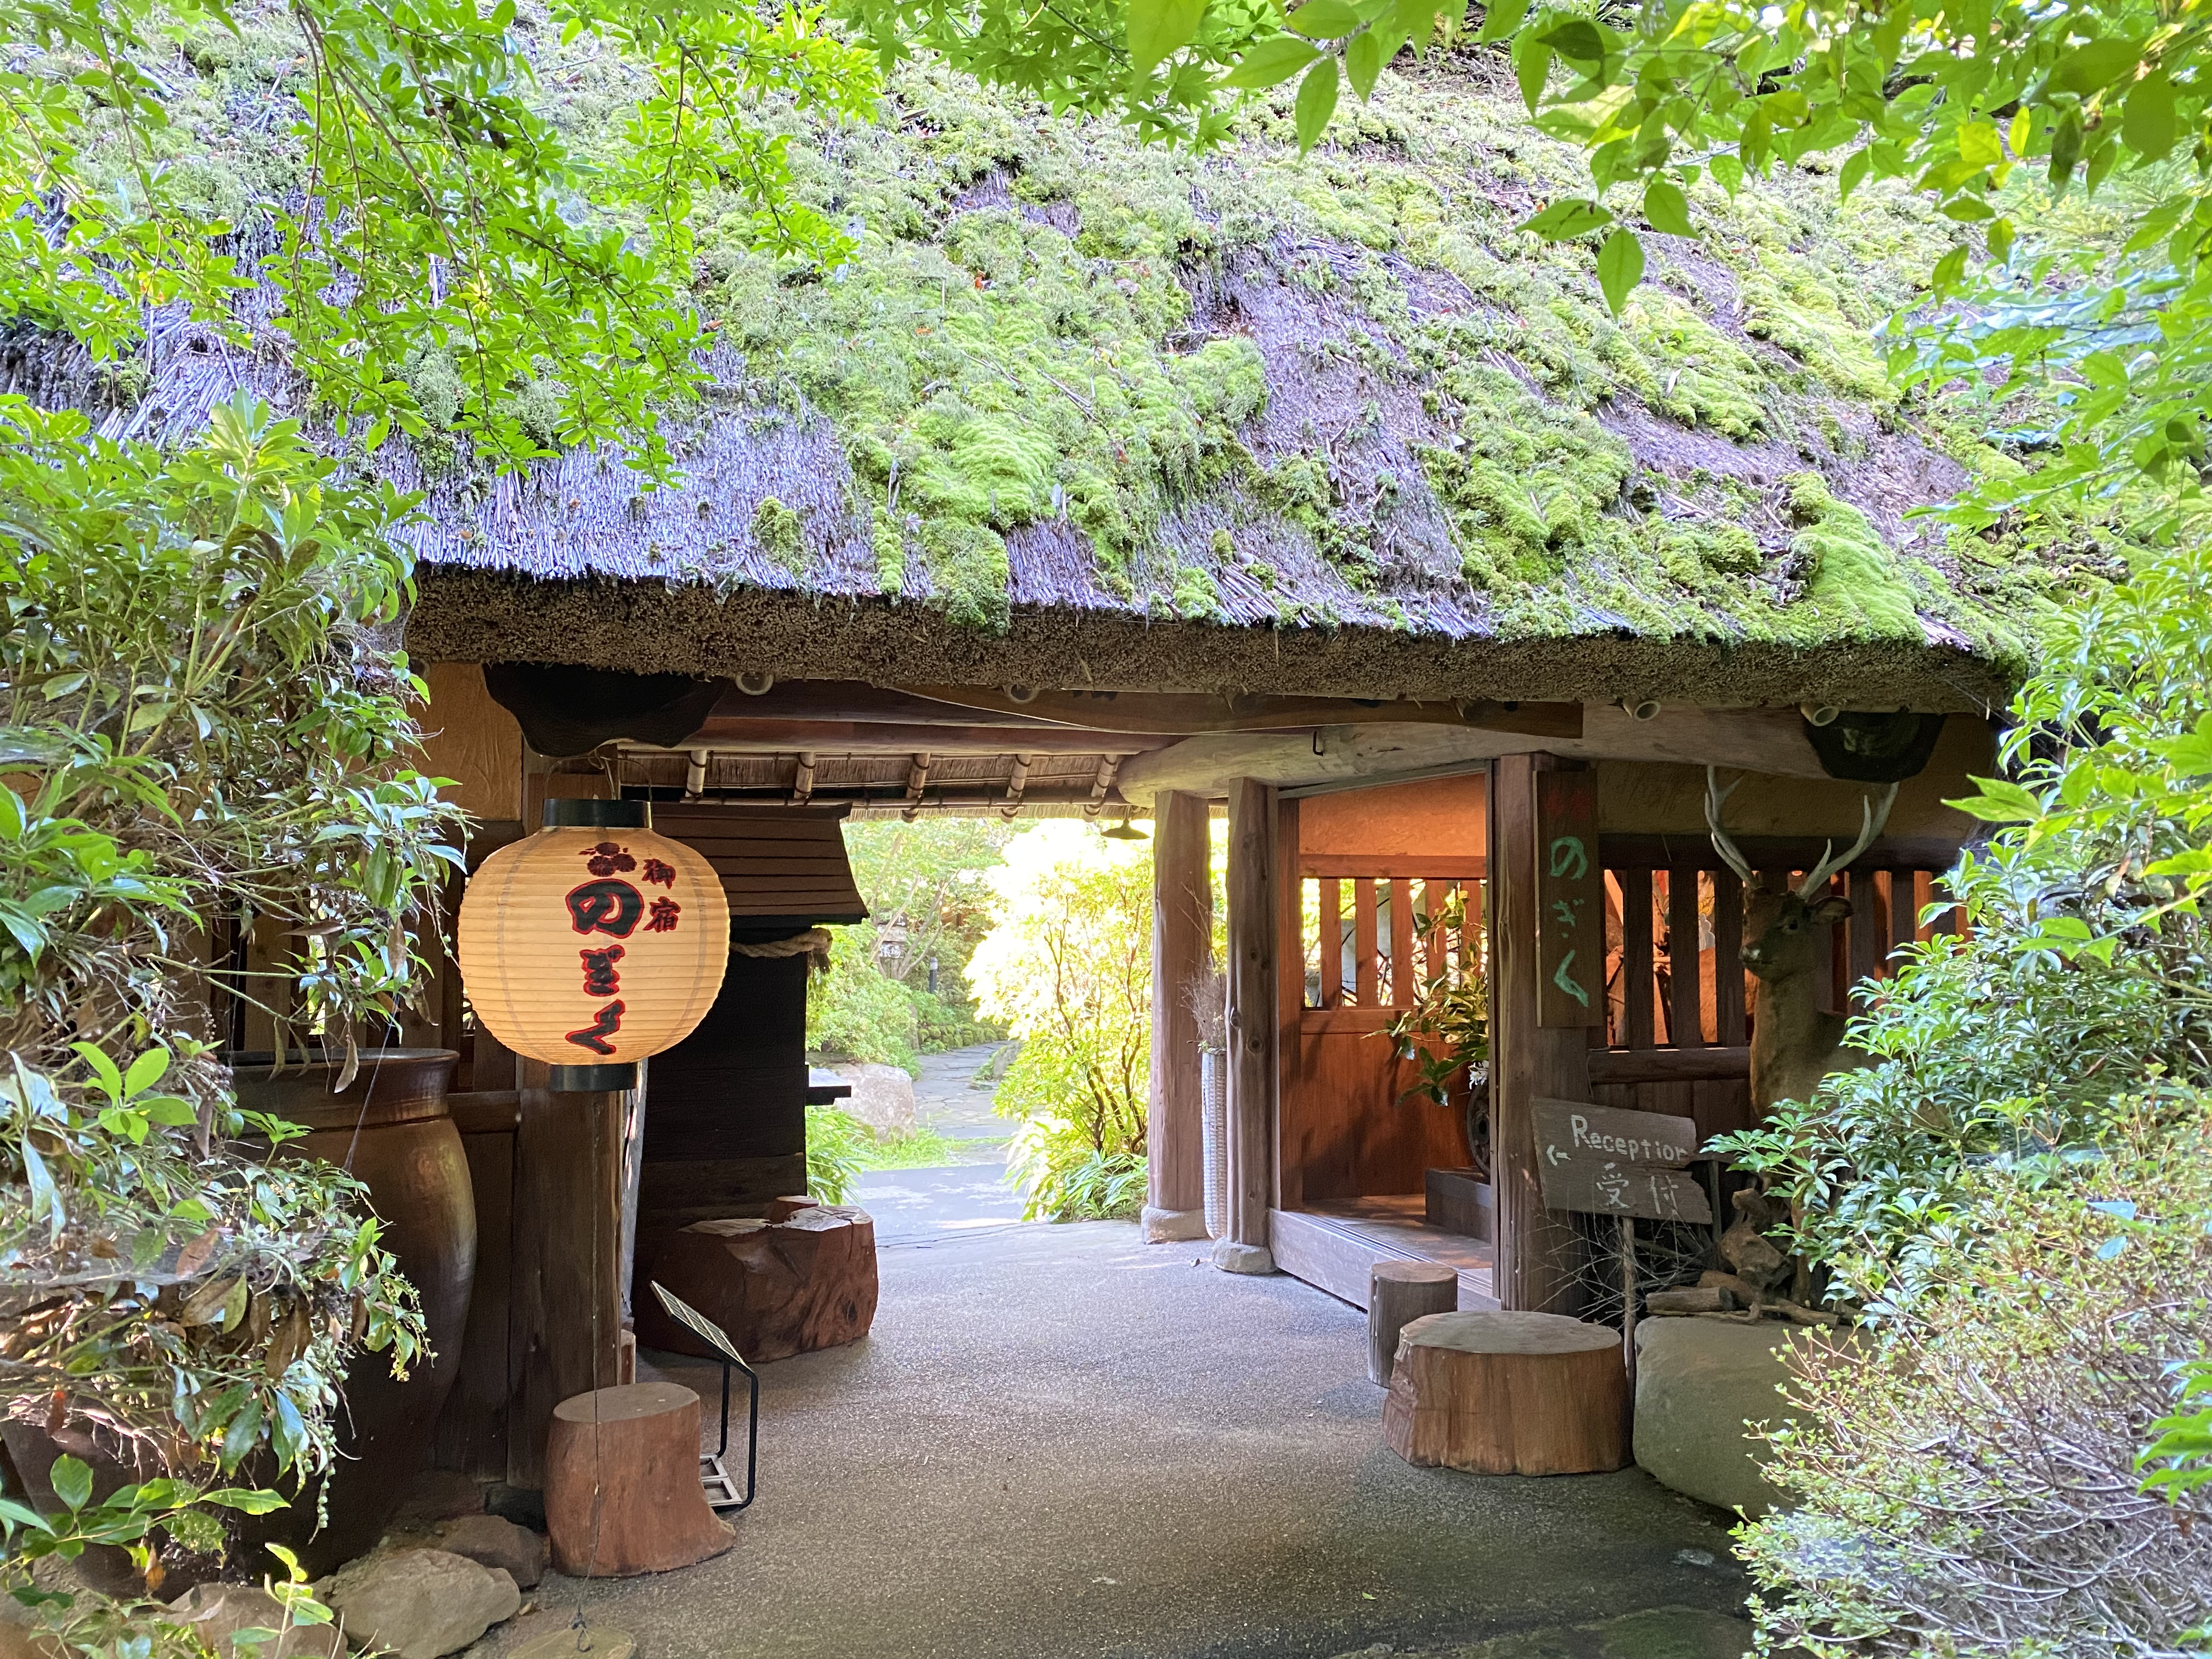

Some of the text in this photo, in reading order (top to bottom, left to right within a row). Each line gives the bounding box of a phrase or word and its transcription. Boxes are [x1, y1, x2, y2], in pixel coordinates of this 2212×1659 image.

[643, 859, 681, 932] 御宿
[1550, 836, 1589, 1007] のぎく
[565, 878, 644, 1054] のぎく
[1596, 1162, 1679, 1215] 受付
